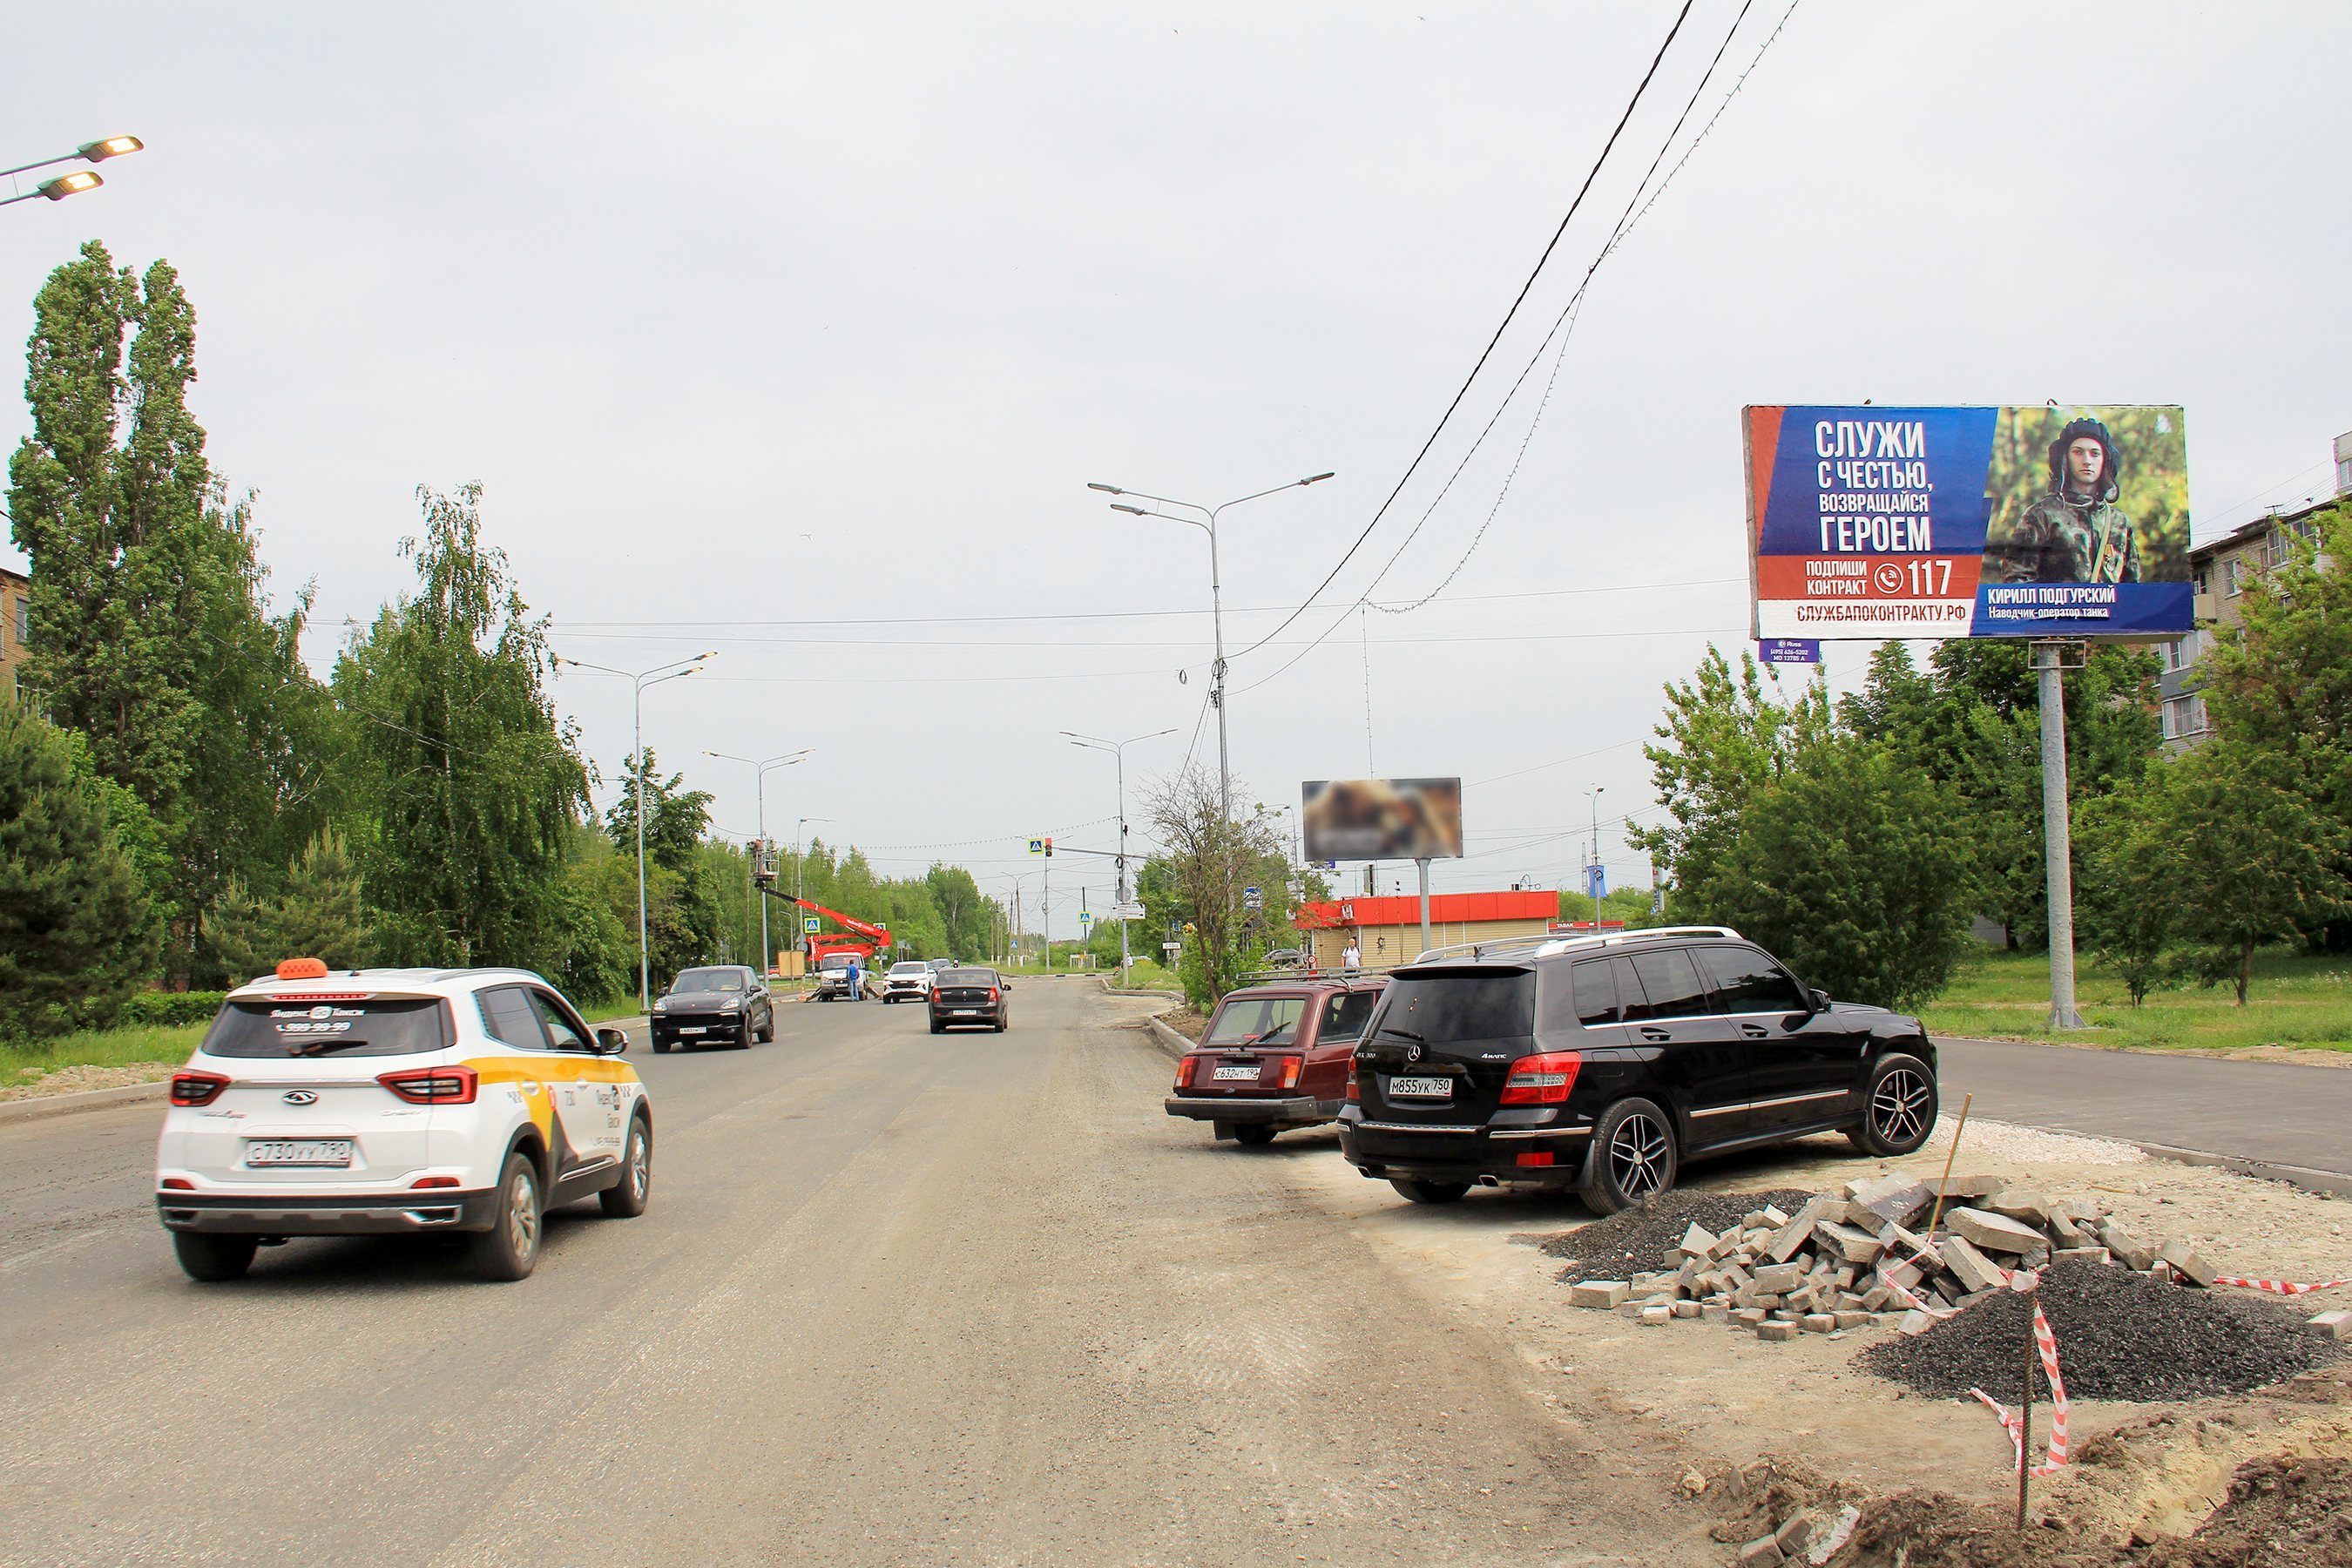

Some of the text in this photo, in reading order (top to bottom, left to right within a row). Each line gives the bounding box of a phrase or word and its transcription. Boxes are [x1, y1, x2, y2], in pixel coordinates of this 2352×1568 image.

[1815, 421, 1925, 458] СЛУЖИ
[1817, 461, 1934, 492] С ЧЕСТЬЮ,
[1819, 490, 1929, 514] ВОЗВРАЩАЙСЯ
[1820, 516, 1931, 551] ГЕРОЕМ
[1806, 560, 1868, 578] ПОДПИШИ
[1907, 559, 1952, 595] 117
[1807, 579, 1868, 595] КОНТРАКТ
[1988, 585, 2116, 605] КИРИЛЛ ПОДГУРСКИЙ
[1797, 605, 1966, 622] СЛУЖБАПОКОНТРАКТУ.РФ
[1989, 606, 2109, 620] Наводчик-оператор танка
[1391, 1078, 1450, 1094] М855УК 750
